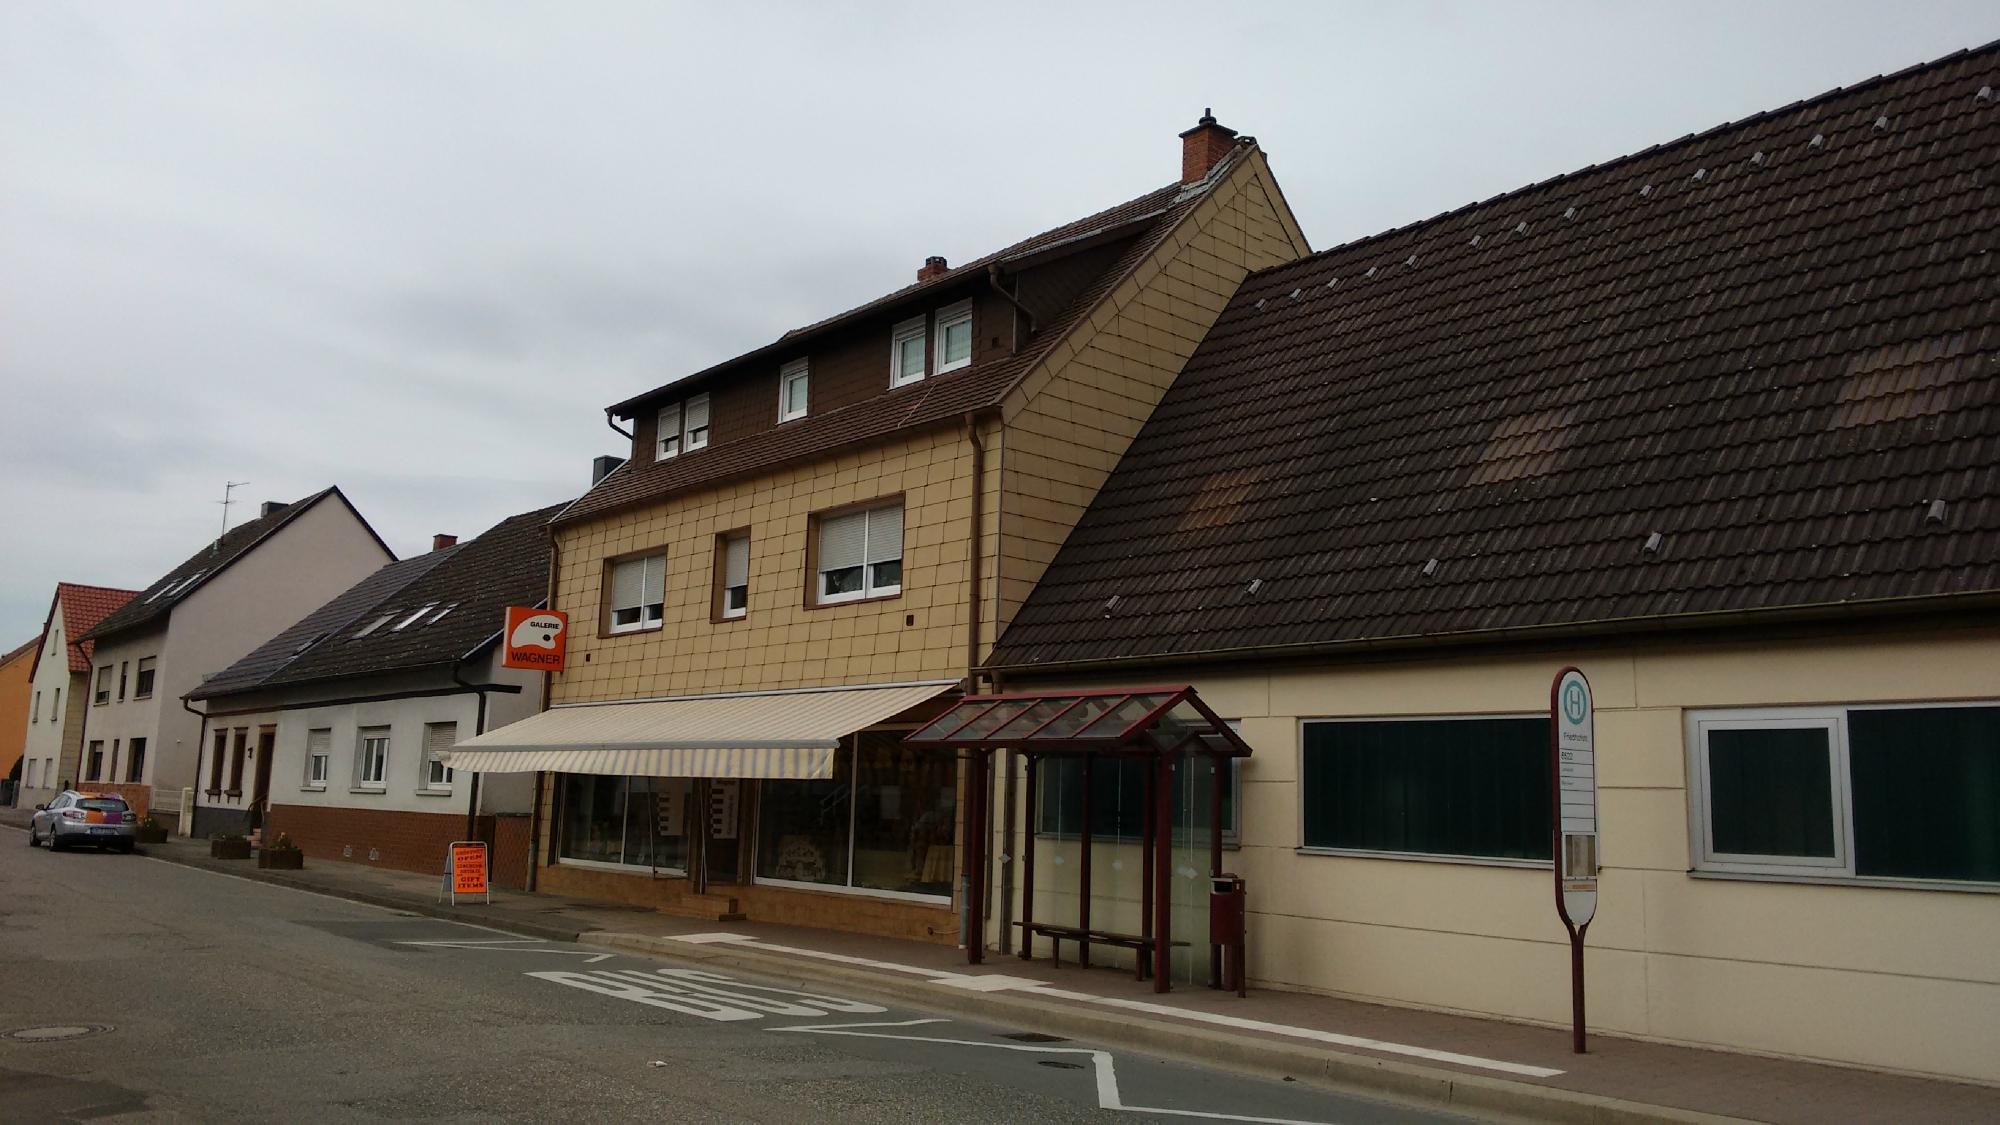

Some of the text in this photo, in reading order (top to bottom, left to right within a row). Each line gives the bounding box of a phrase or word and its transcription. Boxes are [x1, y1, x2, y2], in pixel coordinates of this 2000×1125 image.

[530, 621, 560, 630] GALERIE
[511, 651, 561, 664] WAGNER
[1570, 690, 1581, 716] H
[522, 968, 889, 1022] BUS
